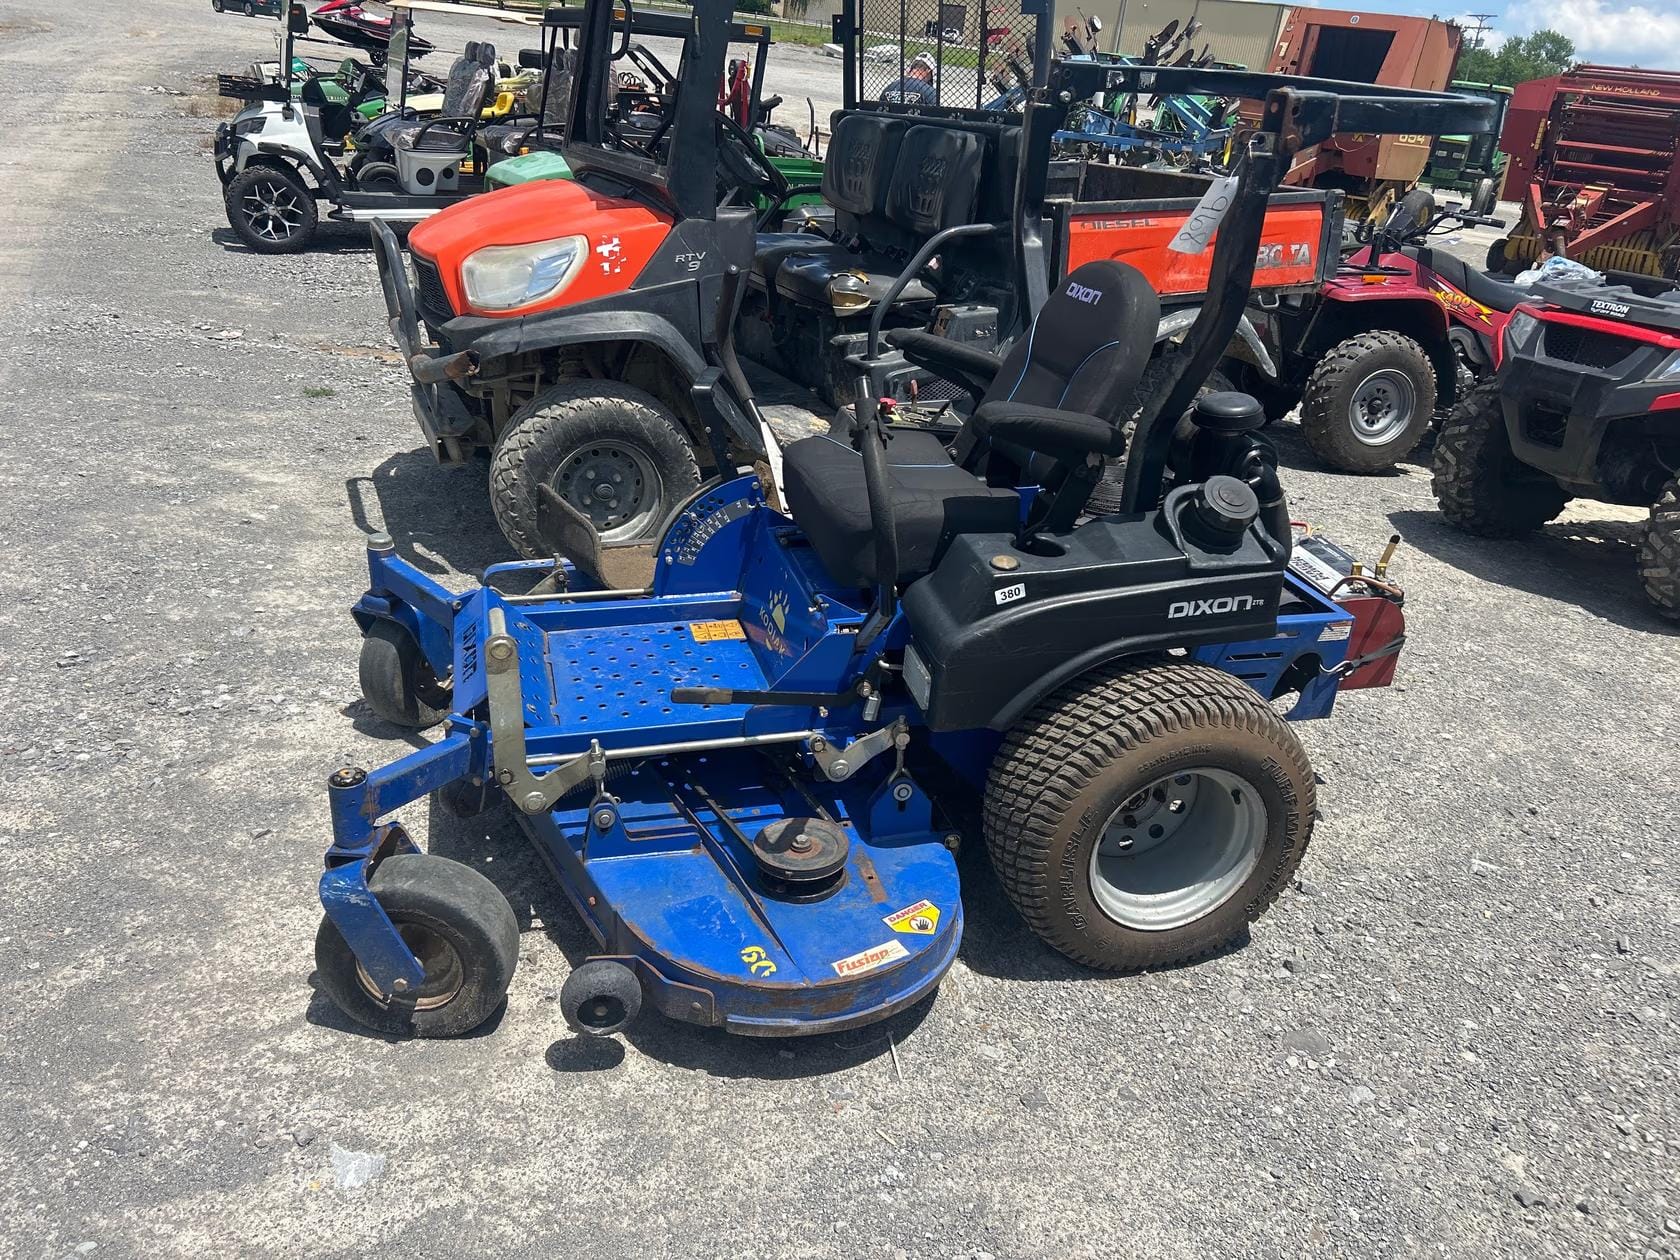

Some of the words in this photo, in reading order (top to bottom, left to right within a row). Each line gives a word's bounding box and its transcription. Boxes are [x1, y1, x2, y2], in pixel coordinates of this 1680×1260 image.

[1591, 84, 1613, 92] NEW
[1614, 86, 1660, 96] HOLLAND
[1081, 218, 1158, 230] DIESEL
[675, 252, 706, 262] RTV
[1256, 243, 1311, 268] BOTA
[1066, 282, 1103, 306] DIXON
[1592, 300, 1630, 313] TEXTRON
[1000, 587, 1021, 601] 380
[1168, 595, 1253, 619] DIXON
[1261, 755, 1298, 807] TURF
[887, 902, 928, 924] DANGER
